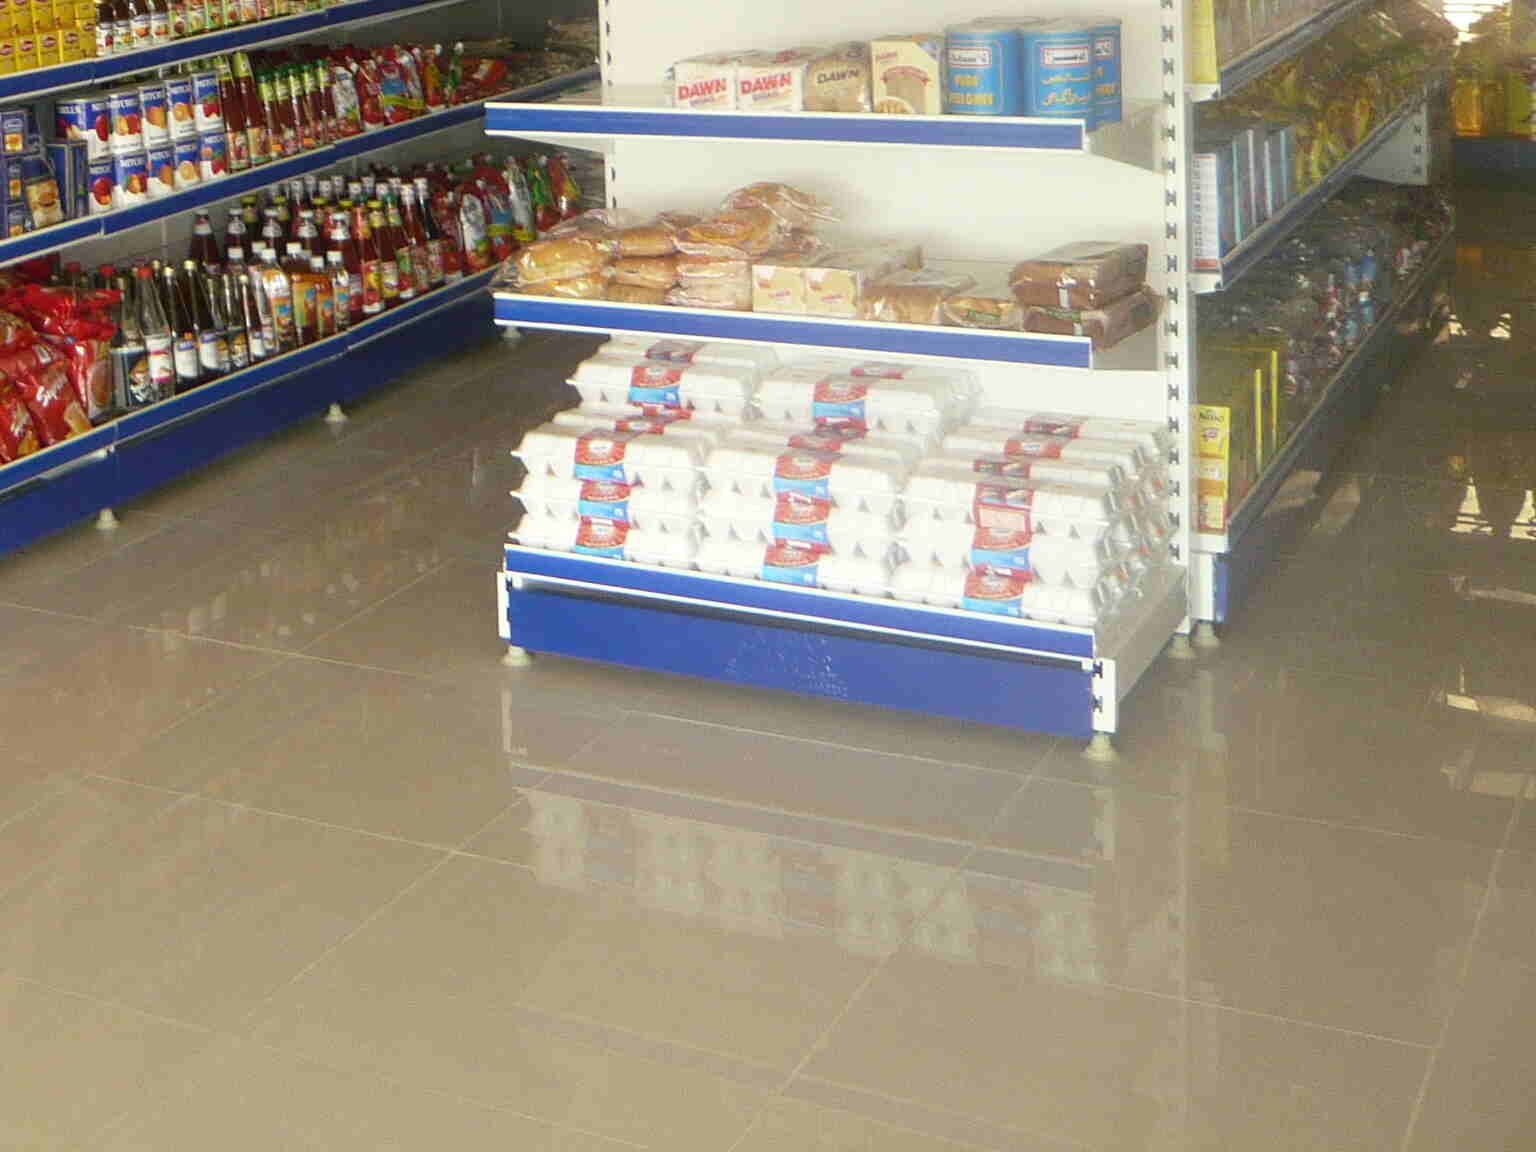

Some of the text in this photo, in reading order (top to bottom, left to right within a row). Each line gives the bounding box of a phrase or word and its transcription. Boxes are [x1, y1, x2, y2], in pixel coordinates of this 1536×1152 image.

[740, 72, 793, 95] DAWN
[817, 69, 860, 85] DAWN
[677, 78, 728, 100] DAWN
